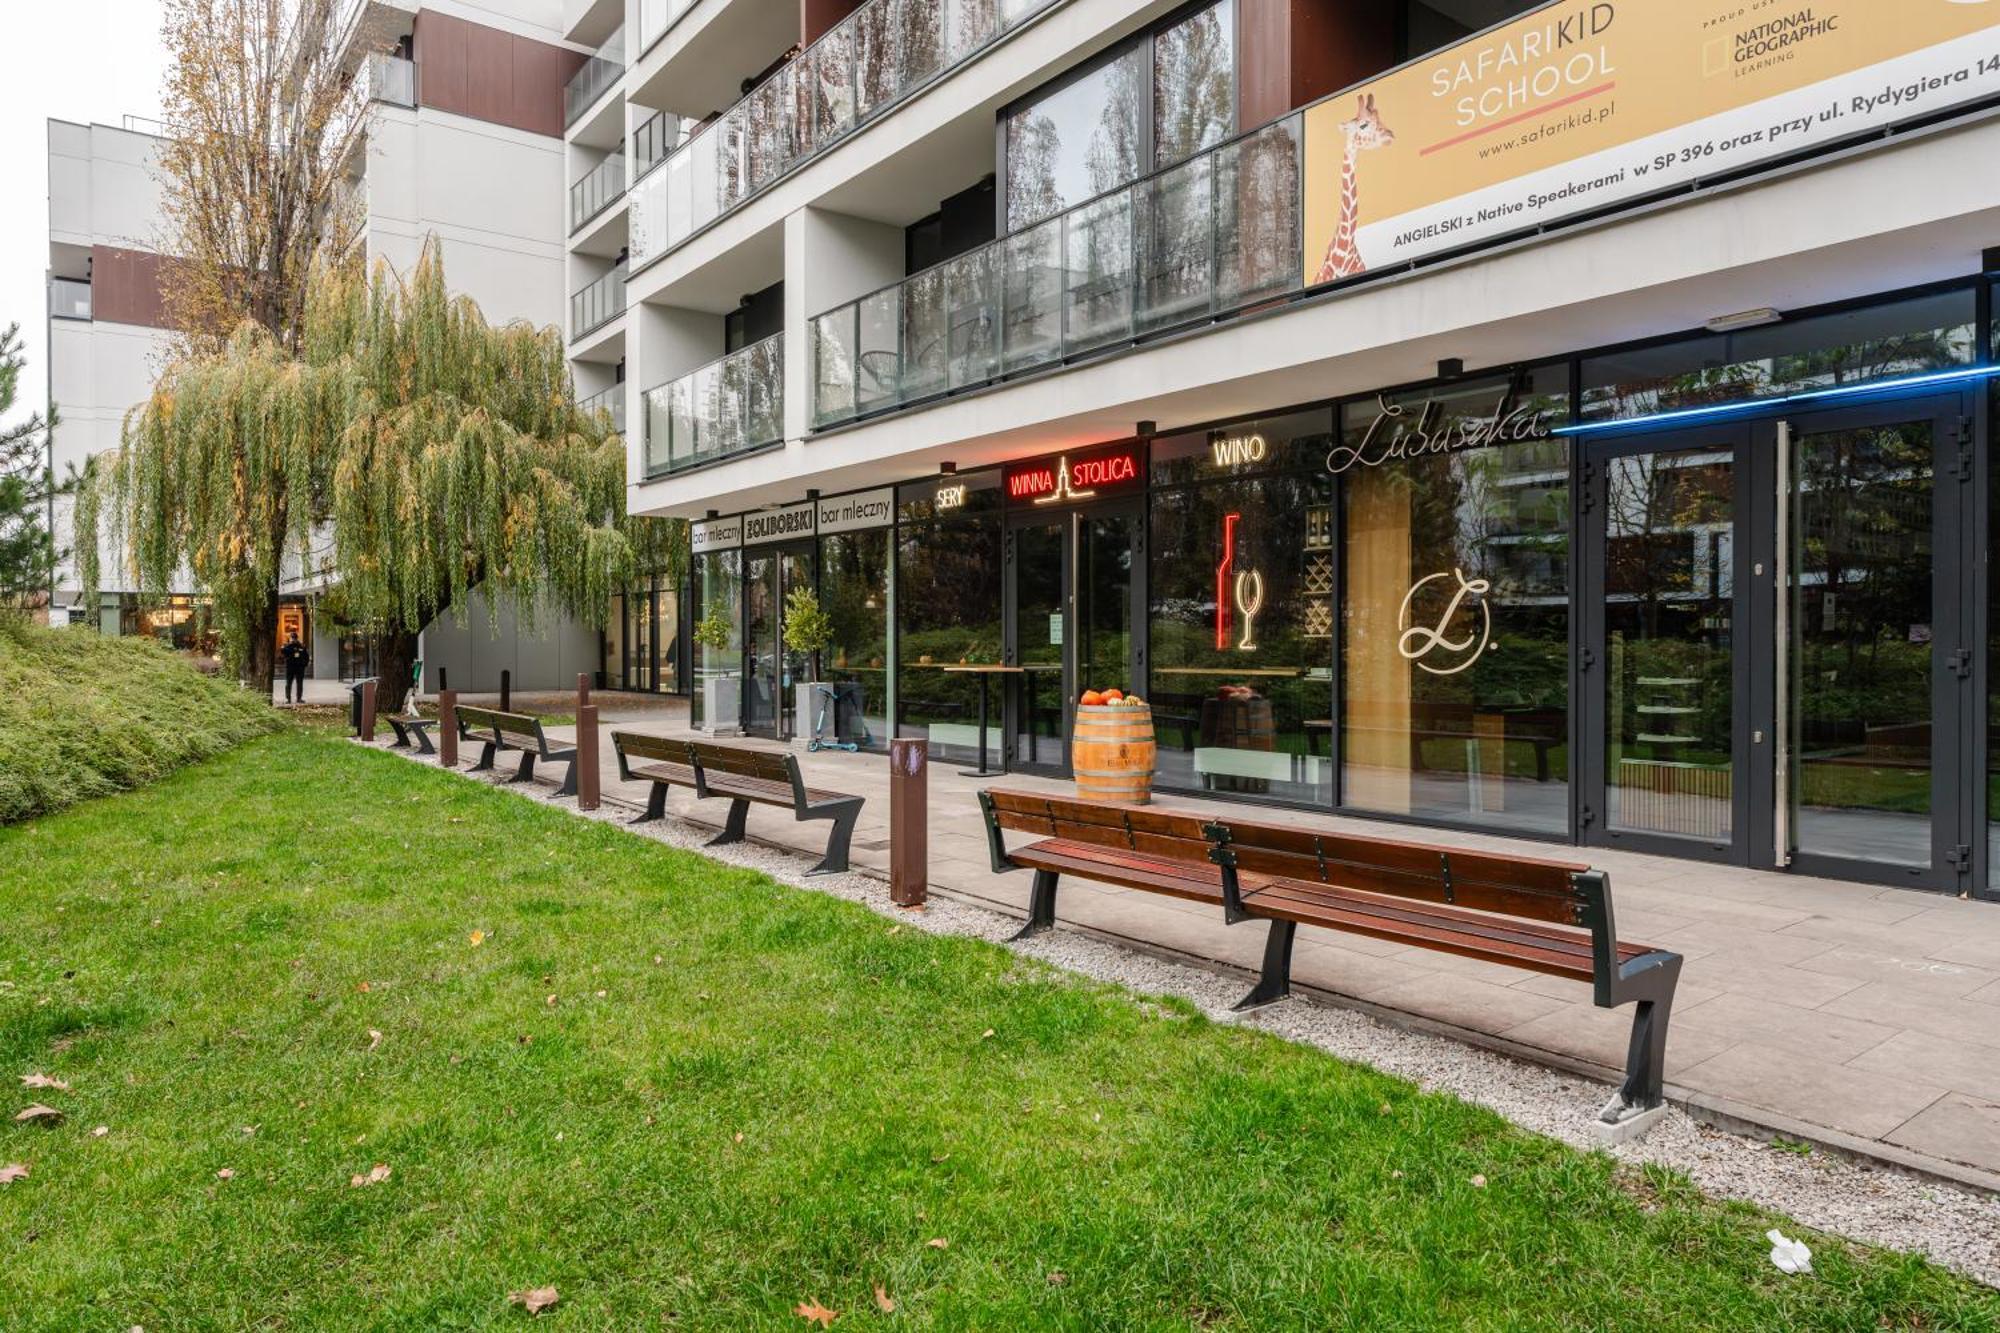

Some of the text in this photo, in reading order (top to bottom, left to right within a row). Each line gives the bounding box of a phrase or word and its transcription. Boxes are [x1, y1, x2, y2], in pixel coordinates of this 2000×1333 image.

[1703, 8, 1745, 29] PROUD
[1735, 8, 1816, 47] NATIONAL
[1431, 3, 1615, 97] SAFARIKID
[1734, 15, 1839, 63] GEOGRAPHIC
[1734, 50, 1795, 78] LEARNING
[1455, 45, 1616, 126] SCHOOL
[1478, 100, 1616, 160] www.safarikid.pl
[1393, 216, 1463, 248] ANGIELSKI
[1466, 214, 1474, 226] z
[1477, 201, 1523, 223] Native
[1527, 167, 1624, 208] Speakerami
[1633, 163, 1649, 177] w
[1653, 152, 1677, 171] SP
[1680, 140, 1715, 163] 396
[1719, 130, 1764, 152] oraz
[1768, 114, 1813, 142] przy
[1819, 102, 1844, 122] ul.
[1852, 68, 1969, 114] Rydygiera
[1213, 436, 1264, 466] WINO
[1010, 456, 1135, 495] WINNA STOLICA
[820, 500, 891, 524] bar mleczny
[938, 486, 965, 508] SERY
[694, 525, 741, 544] bar mleczny
